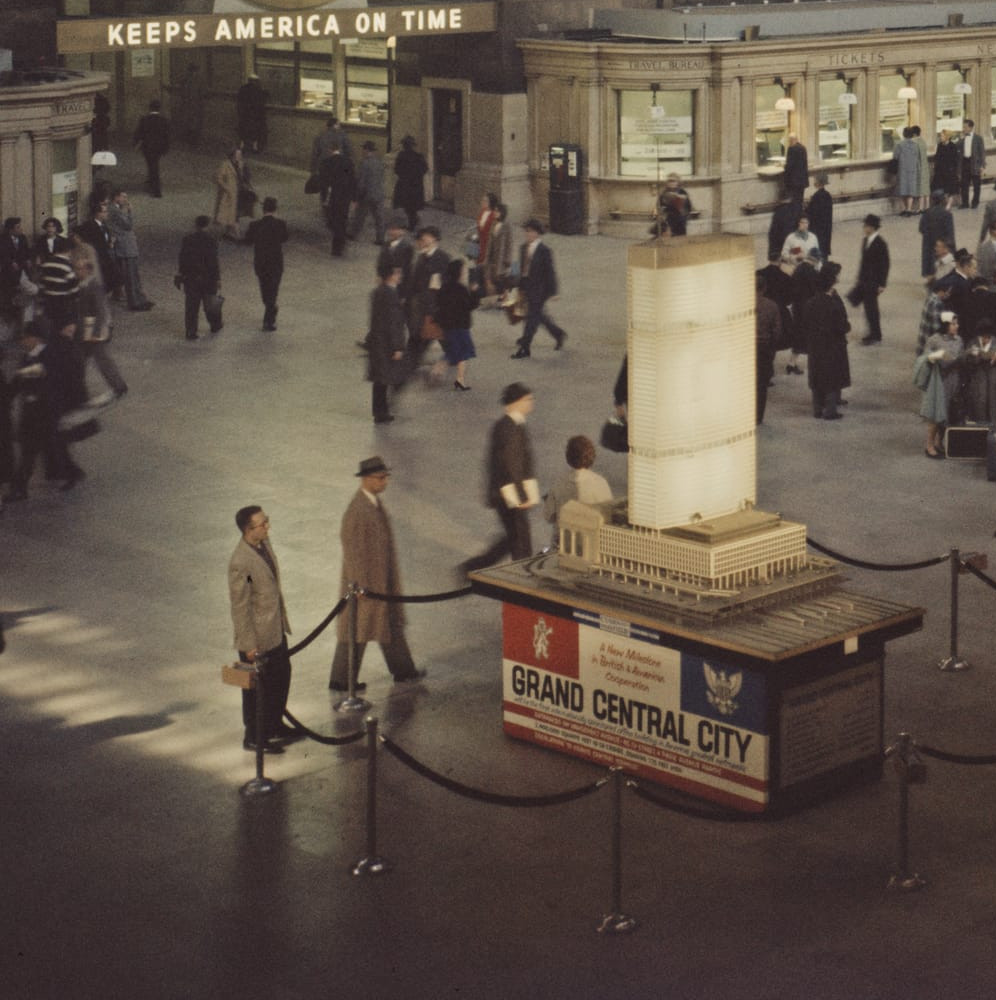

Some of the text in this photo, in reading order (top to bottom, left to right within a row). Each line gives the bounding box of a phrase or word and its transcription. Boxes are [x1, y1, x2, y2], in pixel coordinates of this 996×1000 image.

[108, 8, 463, 46] KEEPS AMERICA ON TIME
[828, 51, 886, 66] TICKETS
[511, 664, 584, 713] GRAND
[592, 689, 691, 746] CENTRAL
[697, 720, 753, 763] CITY
